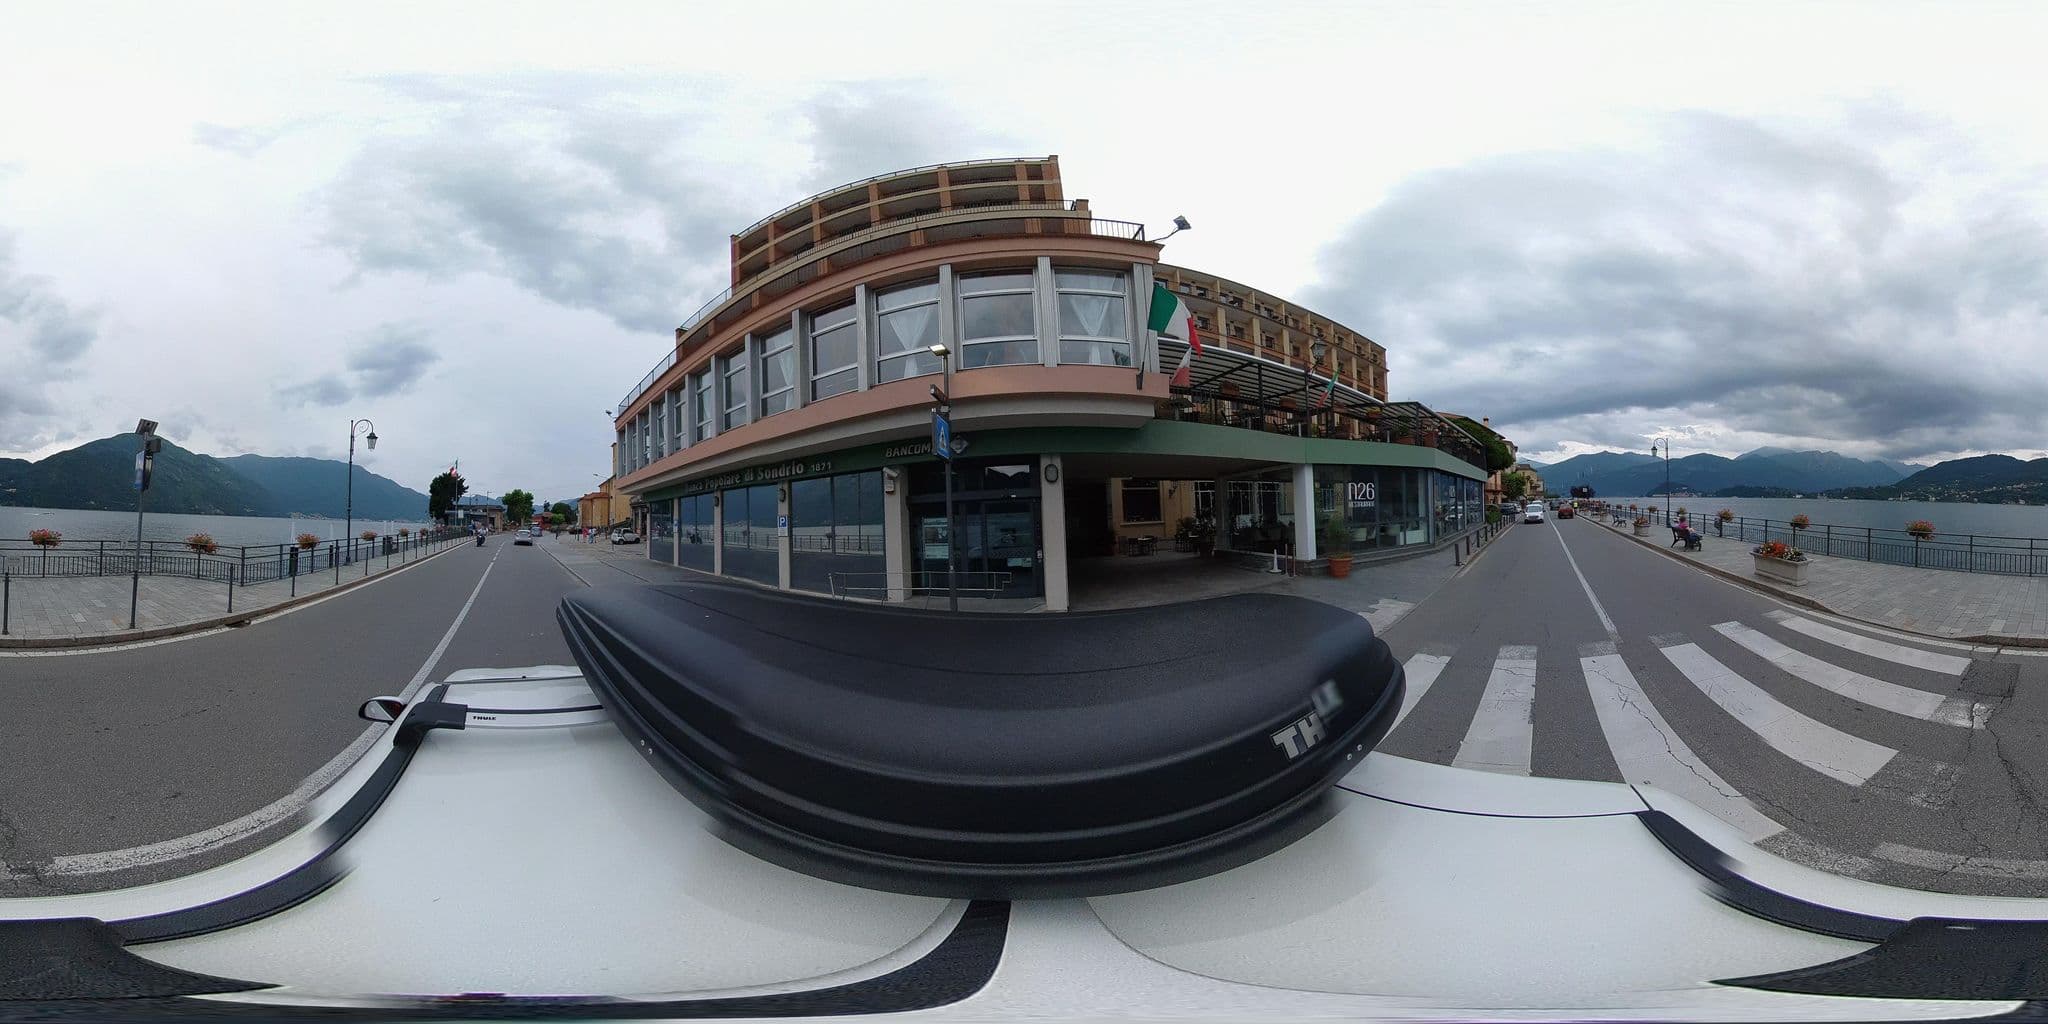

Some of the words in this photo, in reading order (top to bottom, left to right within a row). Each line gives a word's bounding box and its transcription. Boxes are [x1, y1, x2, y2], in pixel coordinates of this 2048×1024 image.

[885, 442, 934, 457] BANCOM
[744, 469, 753, 481] di
[757, 460, 804, 480] Sondrio
[810, 461, 832, 473] 1871
